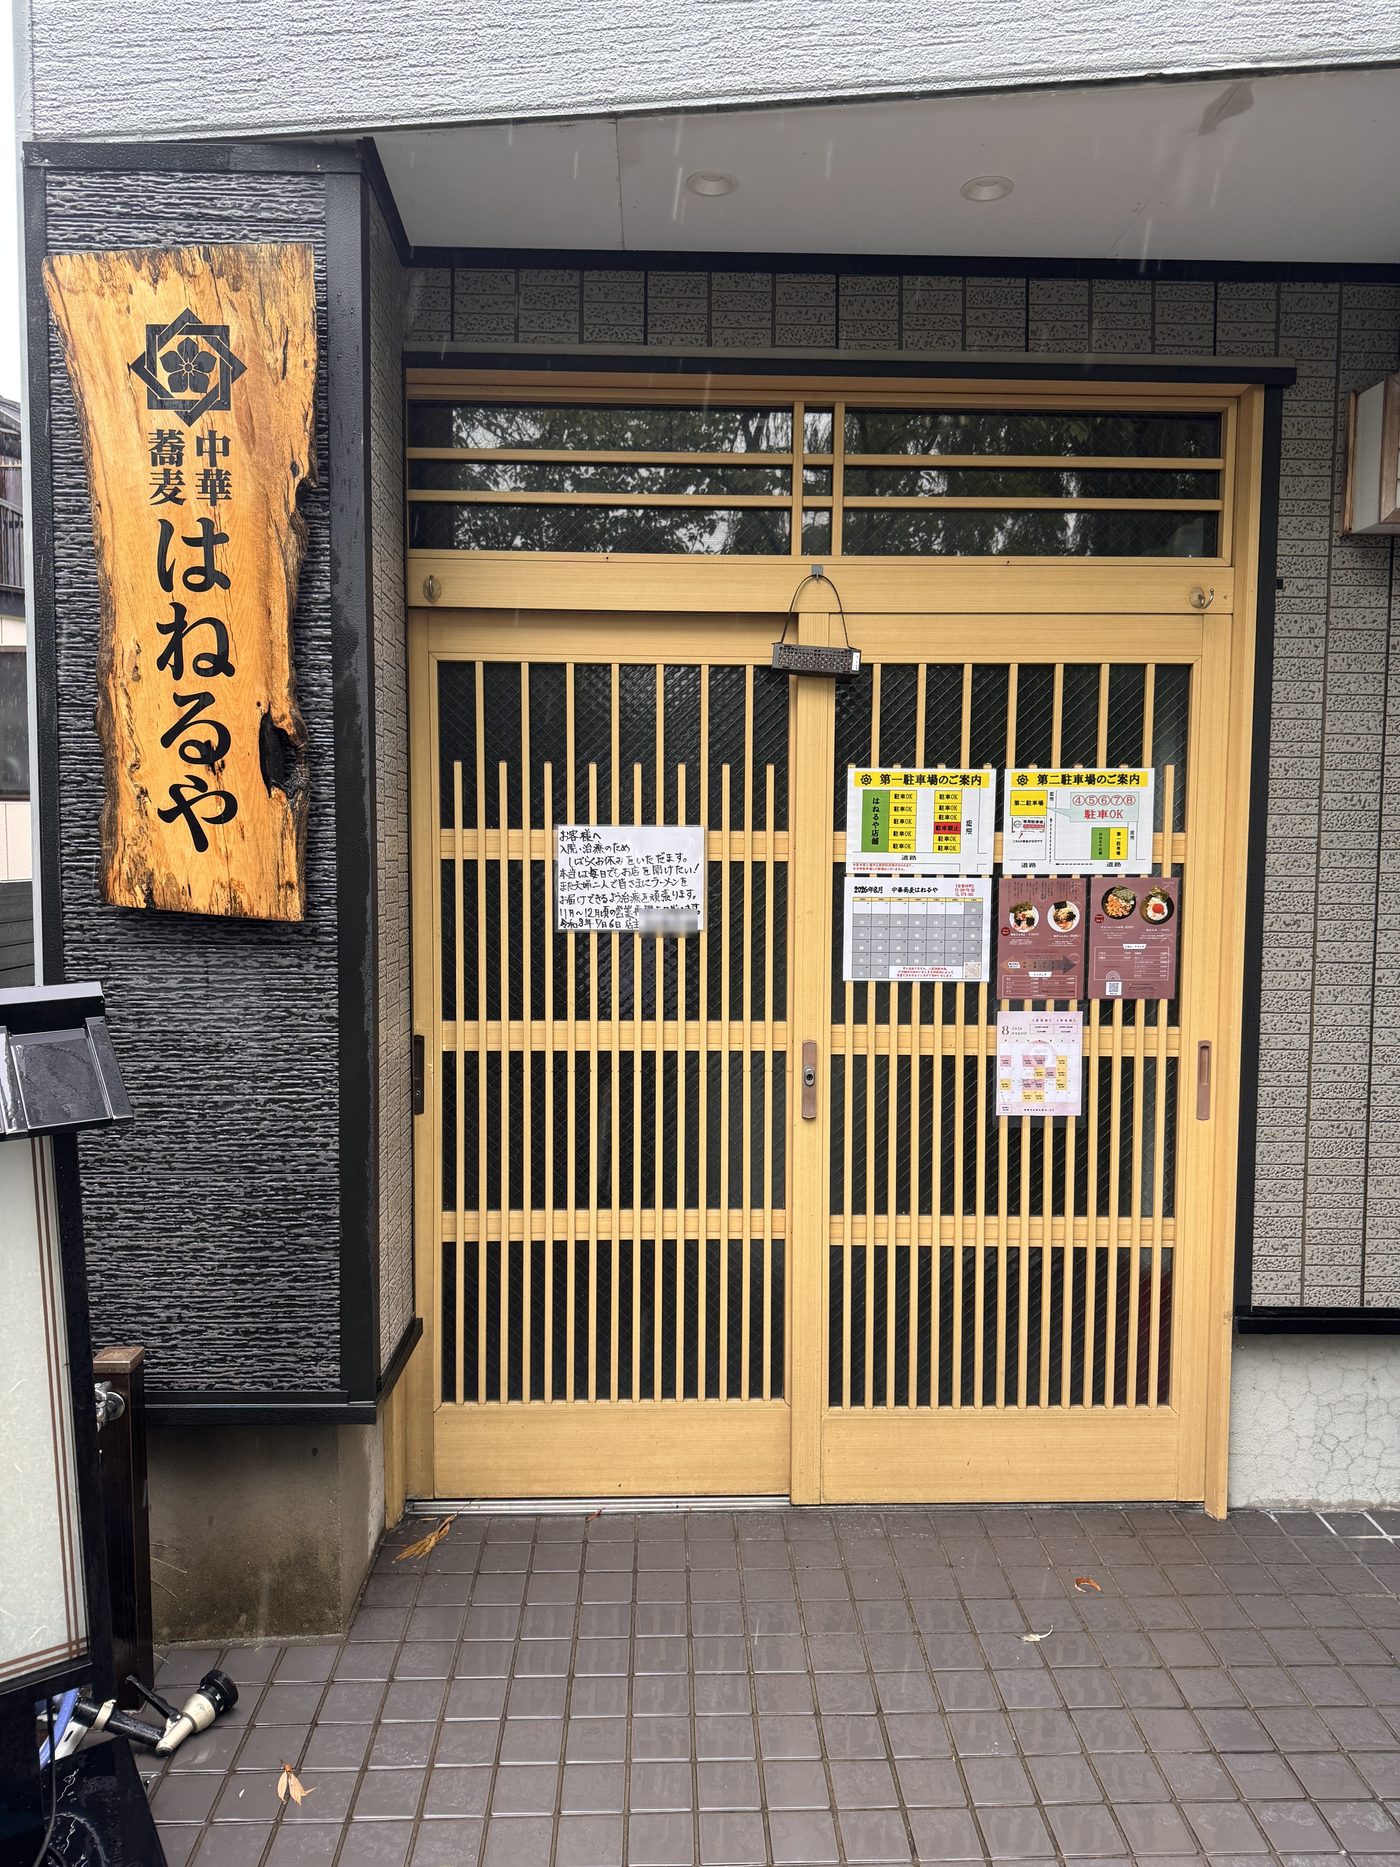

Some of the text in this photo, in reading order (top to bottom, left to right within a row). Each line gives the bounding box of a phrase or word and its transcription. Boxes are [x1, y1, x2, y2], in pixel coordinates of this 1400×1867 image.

[148, 429, 186, 507] 蕎麦
[195, 430, 232, 507] 中華
[156, 517, 238, 853] はねるや
[880, 773, 982, 786] 第一駐車場のご案内
[1037, 773, 1140, 785] 第二駐車場のご案内
[871, 797, 880, 845] はねるや店舗
[1084, 809, 1123, 819] 駐車OK
[559, 828, 602, 842] お客様へ
[1002, 1025, 1009, 1035] 8
